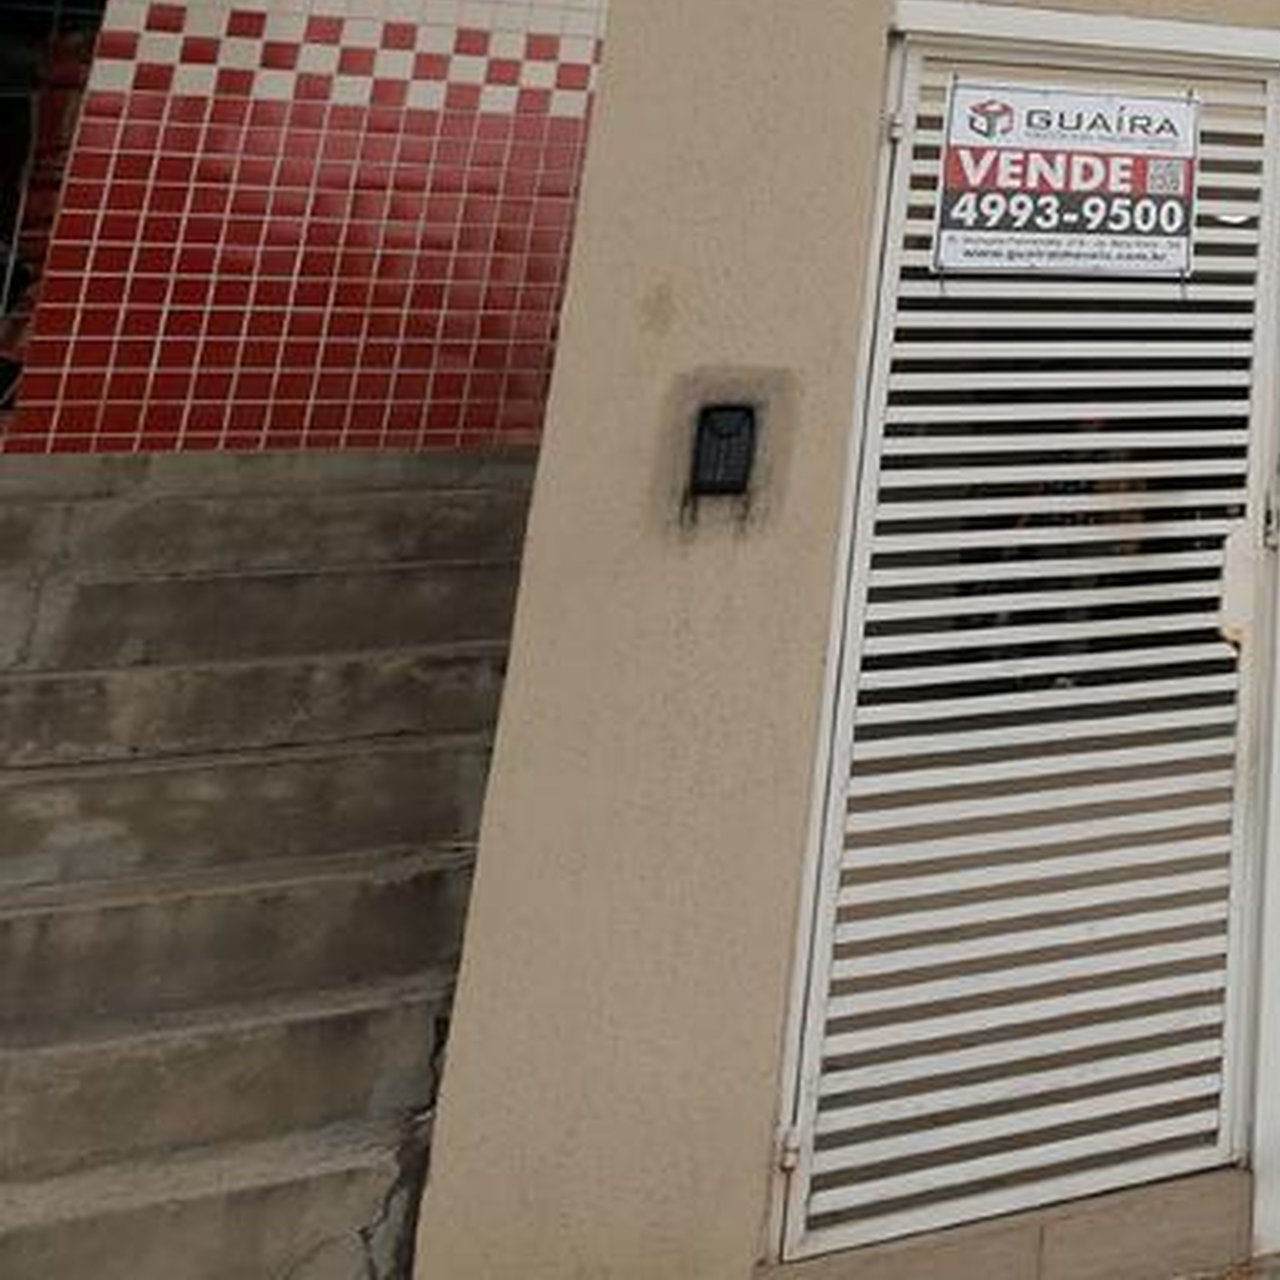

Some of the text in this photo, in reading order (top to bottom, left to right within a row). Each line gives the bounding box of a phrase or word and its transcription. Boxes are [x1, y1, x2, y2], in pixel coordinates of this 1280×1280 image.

[1026, 106, 1178, 137] GUAÍRA
[959, 150, 1133, 193] VENDE
[950, 193, 1184, 233] 4993-9500
